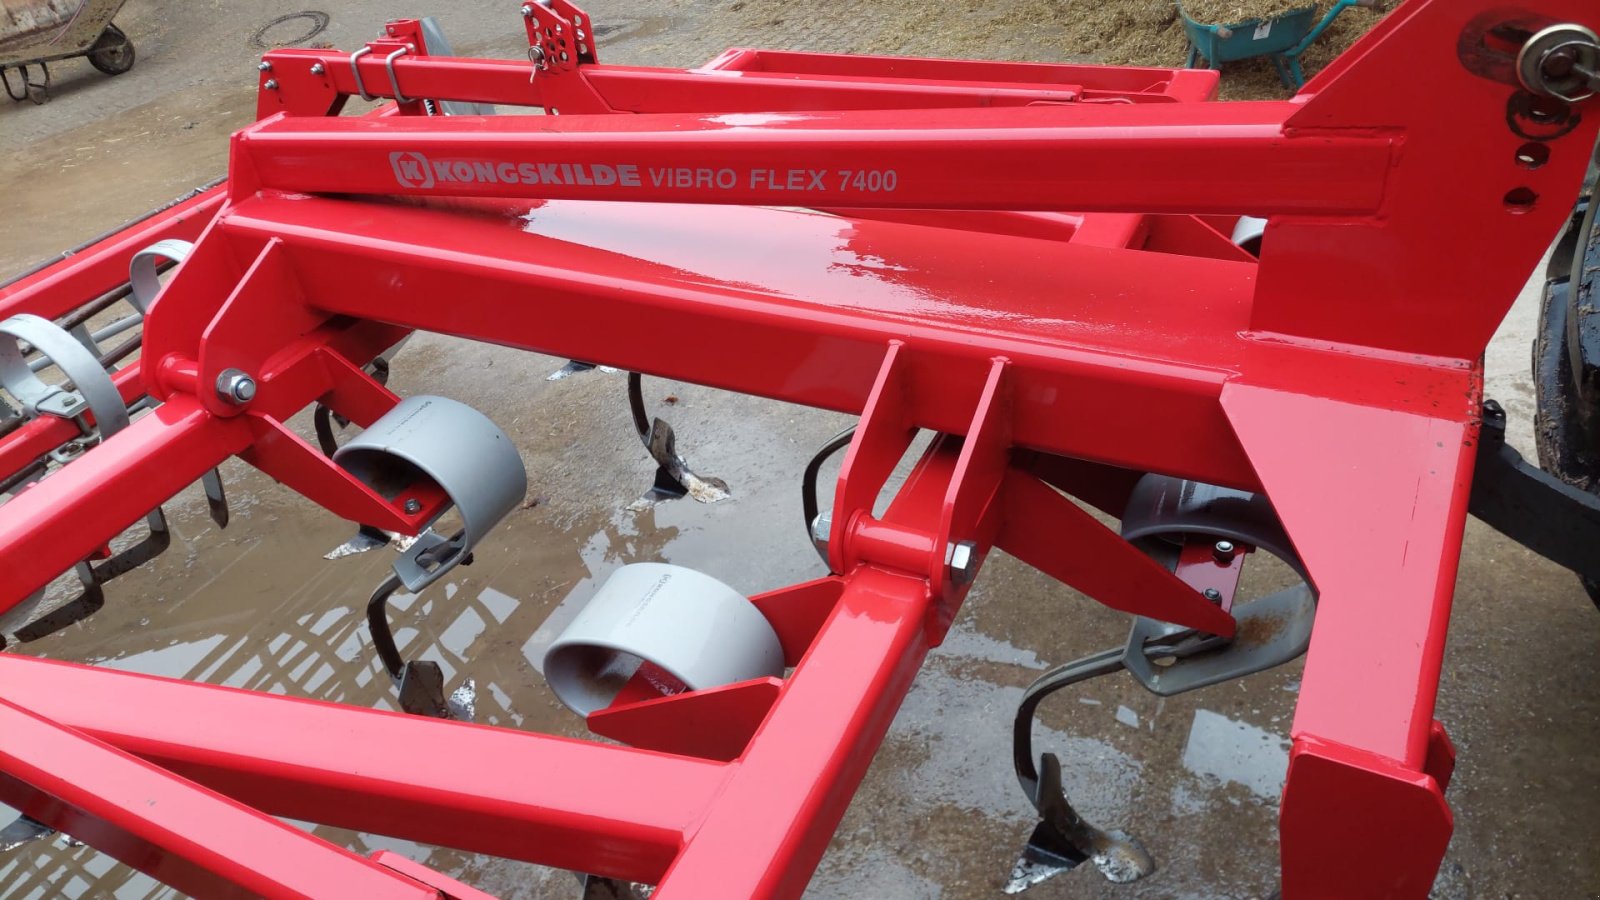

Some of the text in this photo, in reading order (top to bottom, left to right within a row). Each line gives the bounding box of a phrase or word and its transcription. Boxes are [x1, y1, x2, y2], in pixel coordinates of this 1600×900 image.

[433, 162, 641, 187] KONGSKILDE
[649, 168, 737, 189] VIBRO
[750, 169, 825, 191] FLEX
[838, 169, 897, 192] 7400
